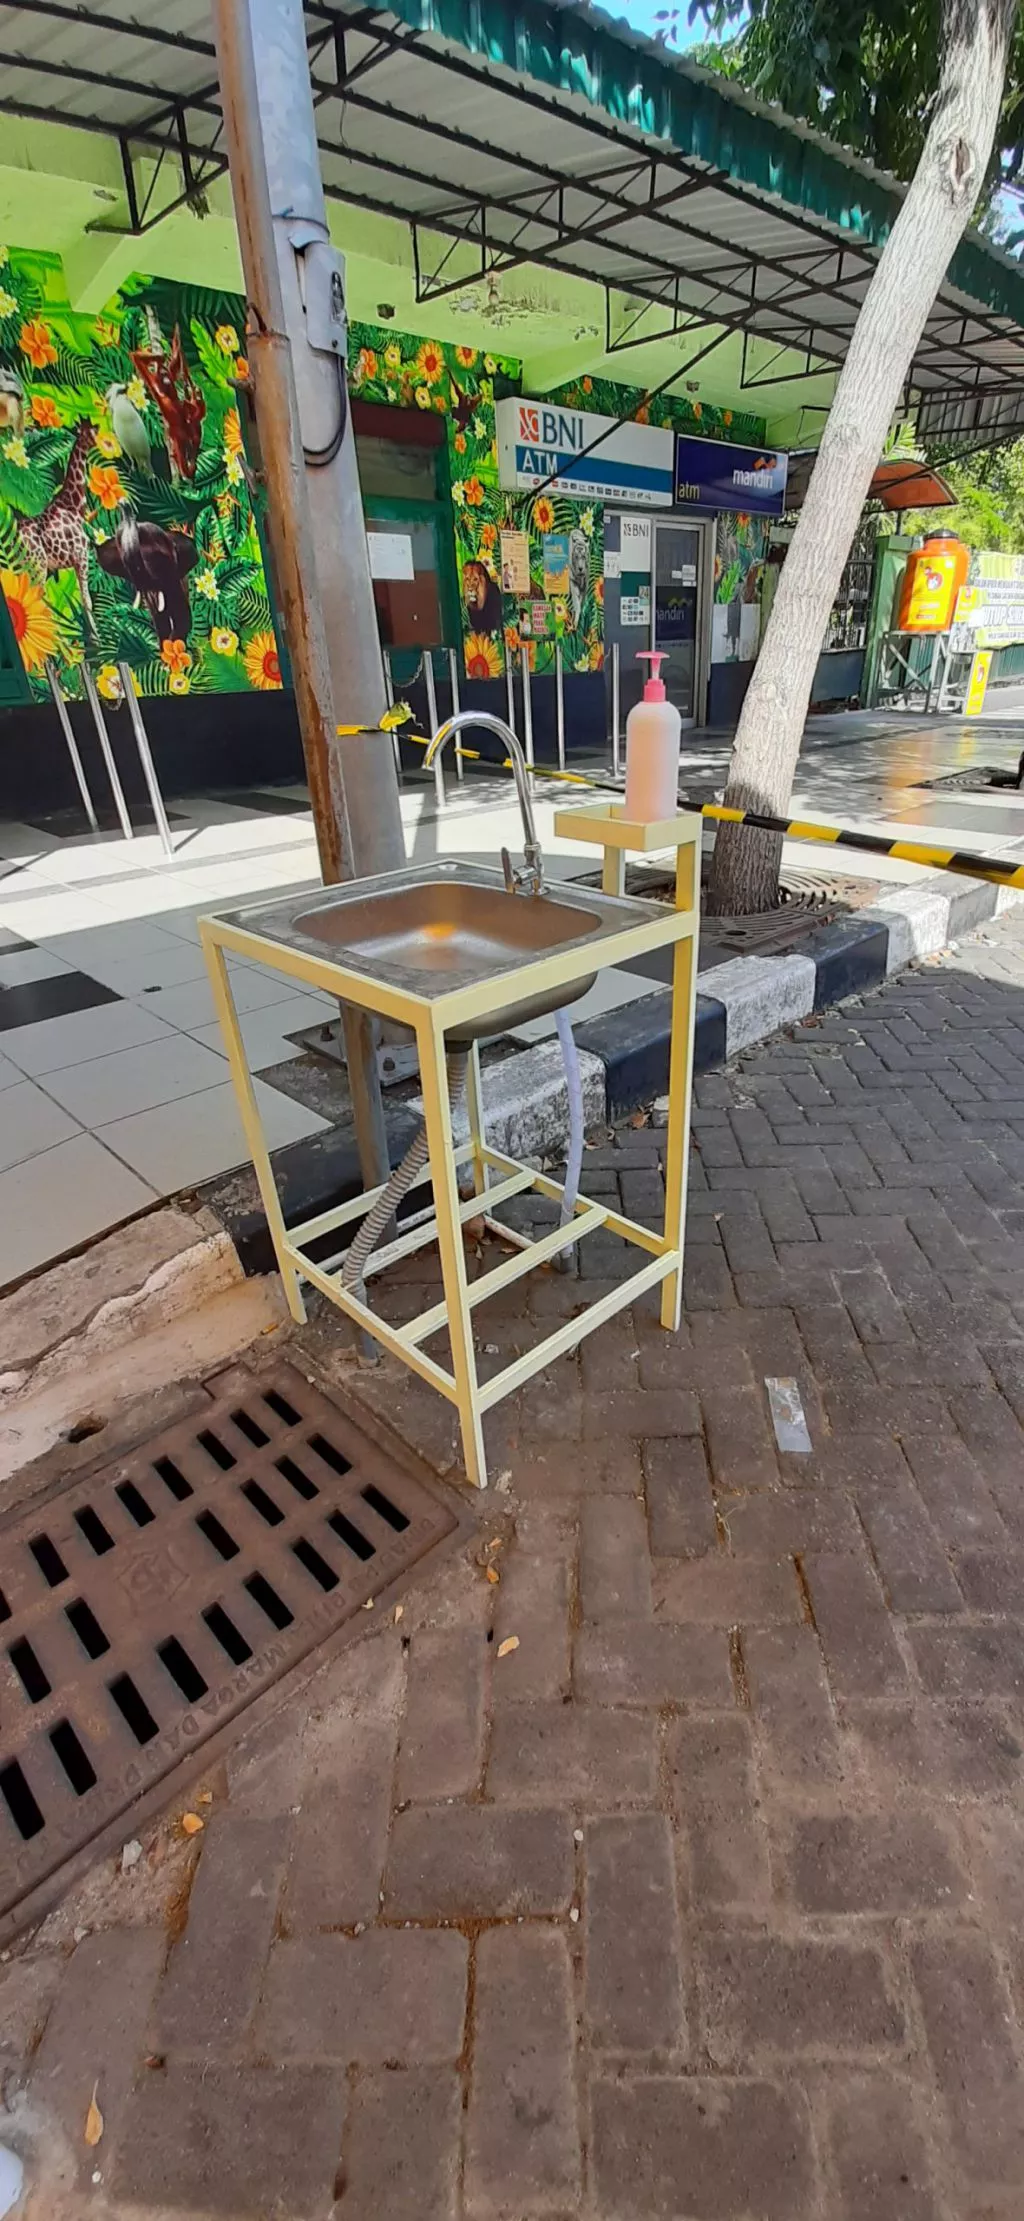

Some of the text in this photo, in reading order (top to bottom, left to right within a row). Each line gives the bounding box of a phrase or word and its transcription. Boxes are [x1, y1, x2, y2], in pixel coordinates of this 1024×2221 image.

[542, 411, 583, 450] BNI
[522, 449, 558, 475] ATM
[732, 467, 773, 489] mandiri
[678, 482, 700, 500] atm
[632, 524, 649, 538] BNI
[201, 1643, 286, 1717] MARGA
